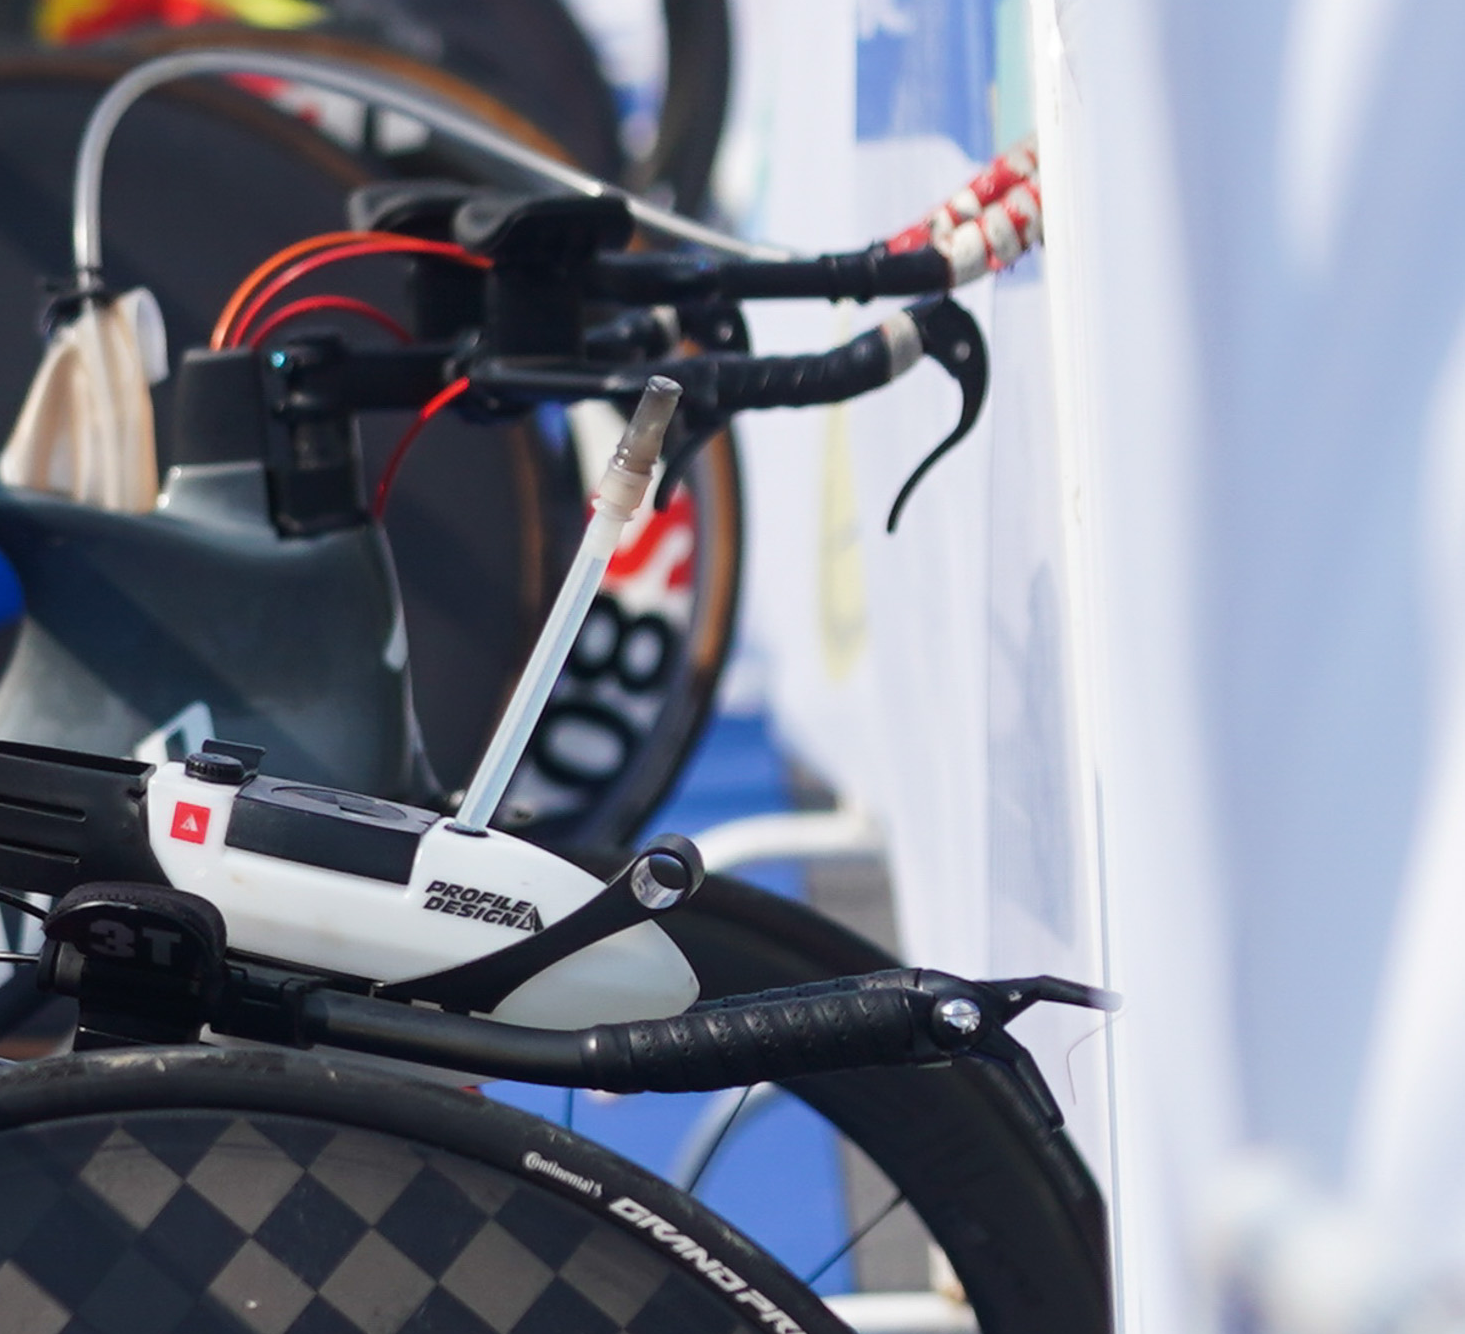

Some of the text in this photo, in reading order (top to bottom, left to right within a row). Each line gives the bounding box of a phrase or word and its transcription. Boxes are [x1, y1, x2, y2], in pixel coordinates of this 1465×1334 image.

[423, 895, 524, 929] DESIGN
[425, 879, 532, 915] PROFILE
[87, 918, 183, 967] 3T
[608, 1196, 749, 1295] GRAND
